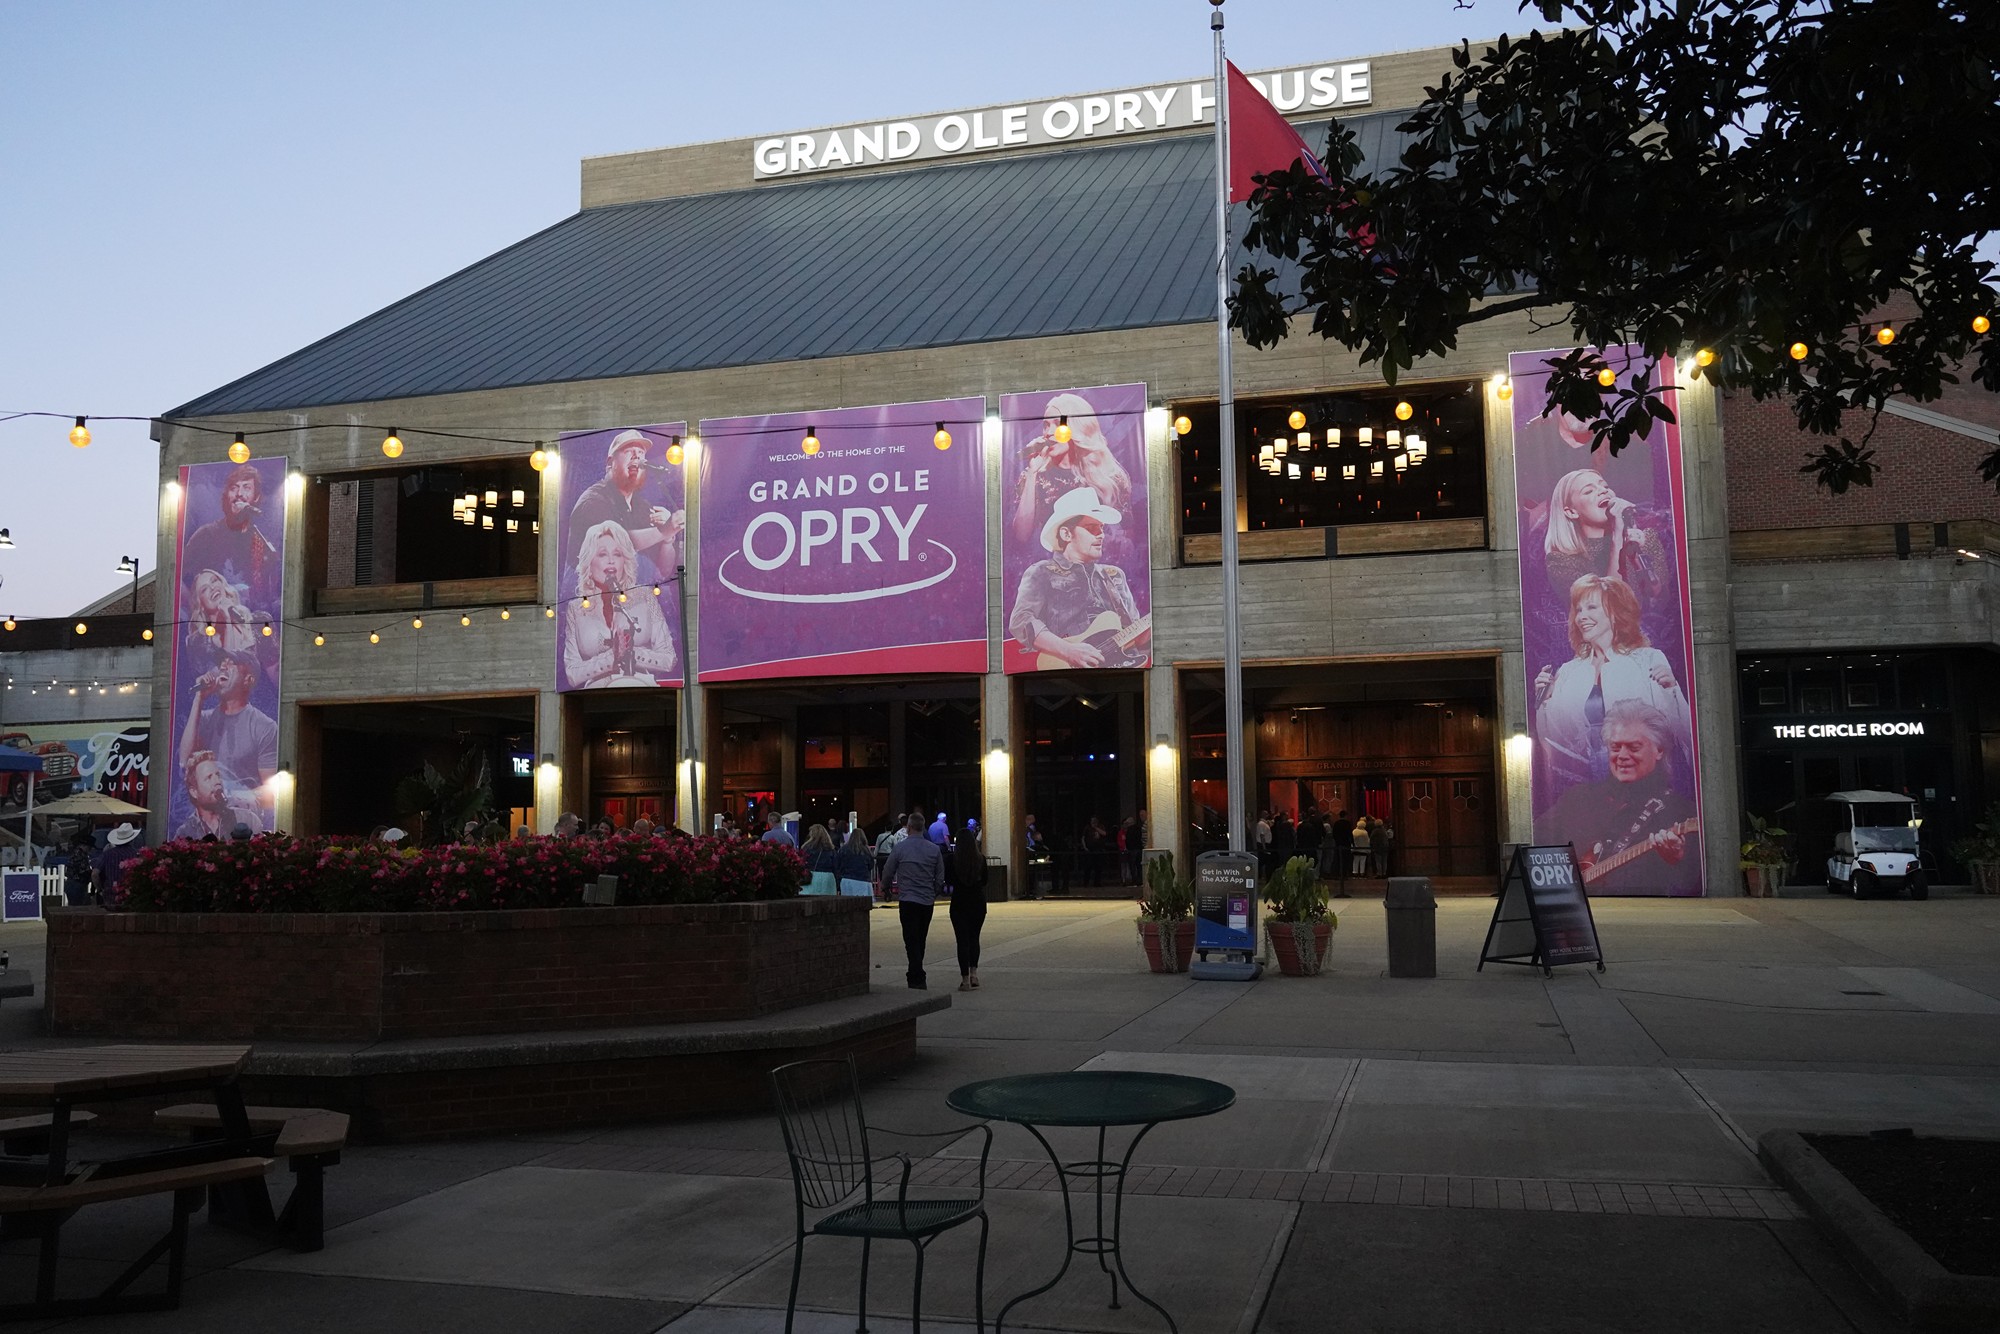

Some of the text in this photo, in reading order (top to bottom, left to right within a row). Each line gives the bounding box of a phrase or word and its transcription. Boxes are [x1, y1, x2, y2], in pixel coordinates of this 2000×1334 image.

[755, 63, 1370, 174] GRAND OLE OPRY HUSE
[769, 445, 905, 462] WELCOME TO THE HOME OF THE
[749, 469, 930, 502] GRAND OLE
[742, 503, 929, 571] OPRY
[1773, 722, 1925, 739] THE CIRCLE ROOM
[512, 757, 530, 773] THE
[1316, 761, 1350, 770] GRAND
[1400, 759, 1432, 768] HOUSE
[83, 781, 145, 792] LOUNG
[1530, 853, 1570, 864] TOUR THE
[1531, 865, 1573, 886] OPRY
[9, 890, 35, 900] Ford
